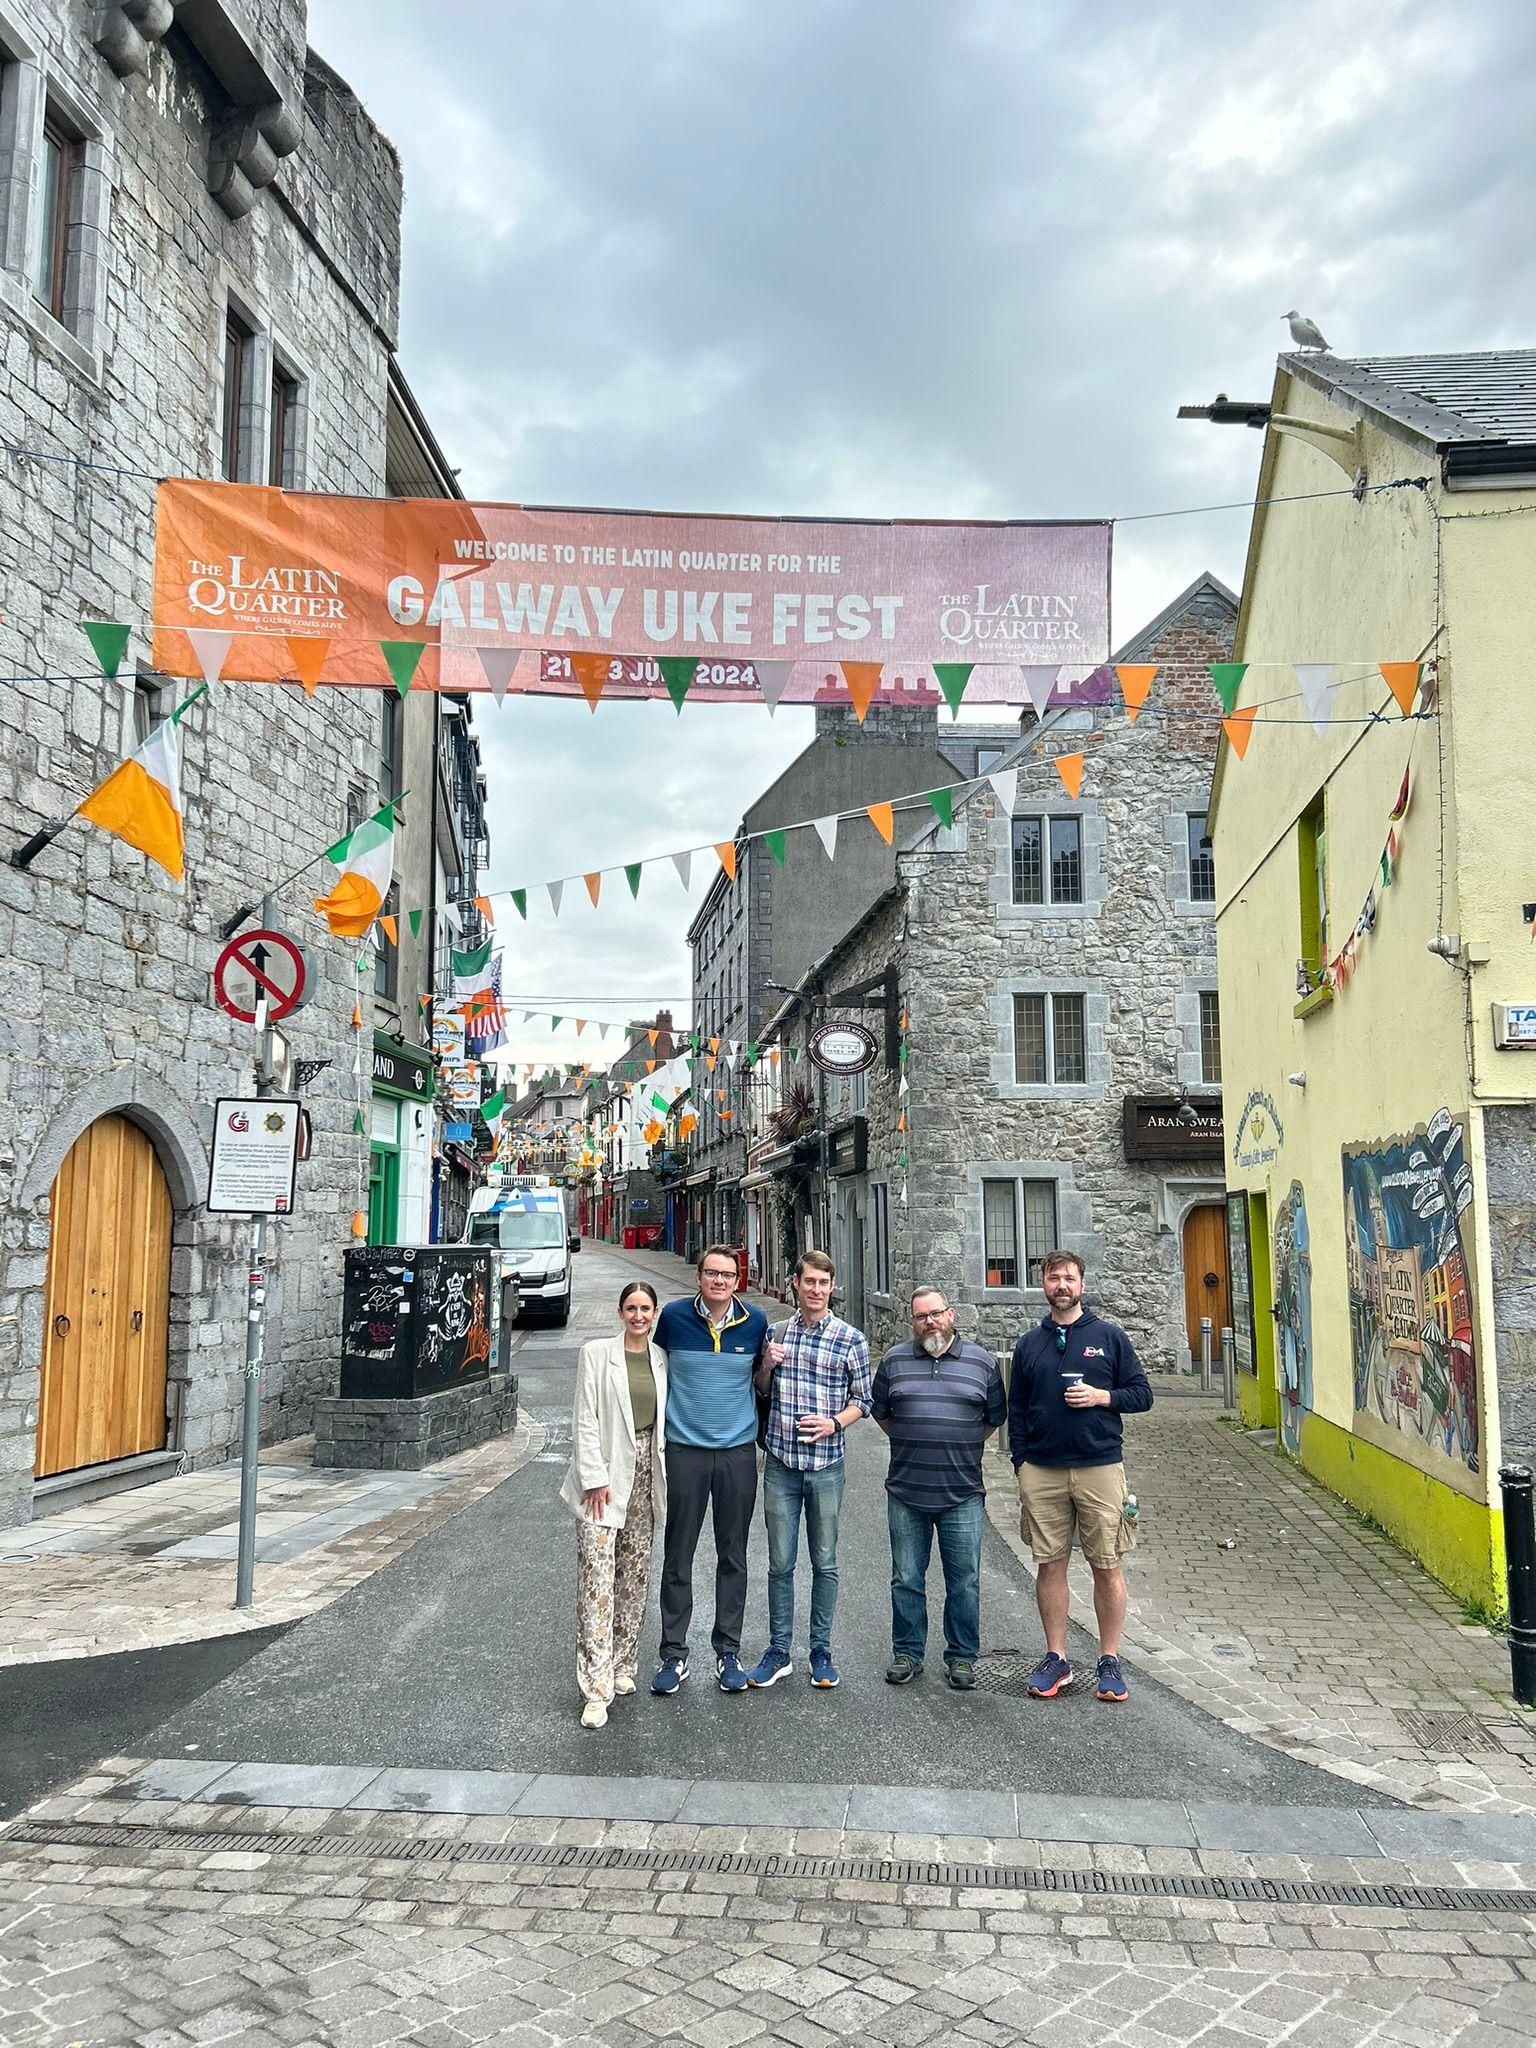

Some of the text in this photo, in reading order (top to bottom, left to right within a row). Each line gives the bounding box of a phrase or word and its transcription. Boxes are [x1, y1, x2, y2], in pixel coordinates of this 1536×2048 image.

[454, 539, 841, 574] WELCOME TO THE LATIN QUARTER FOR THE
[188, 555, 342, 595] THE LATIN
[188, 578, 349, 619] QUARTER
[387, 575, 904, 645] GALWAY UKE FEST
[938, 584, 1077, 618] THE LATIN
[233, 614, 343, 630] WHERE GALWAY COMES ALIVE
[939, 607, 1083, 645] QUARTER
[547, 656, 571, 677] 21
[696, 664, 755, 685] 2024
[1147, 1115, 1185, 1127] ARAN
[1389, 1264, 1412, 1293] LATIN
[1385, 1293, 1416, 1320] QUARTER
